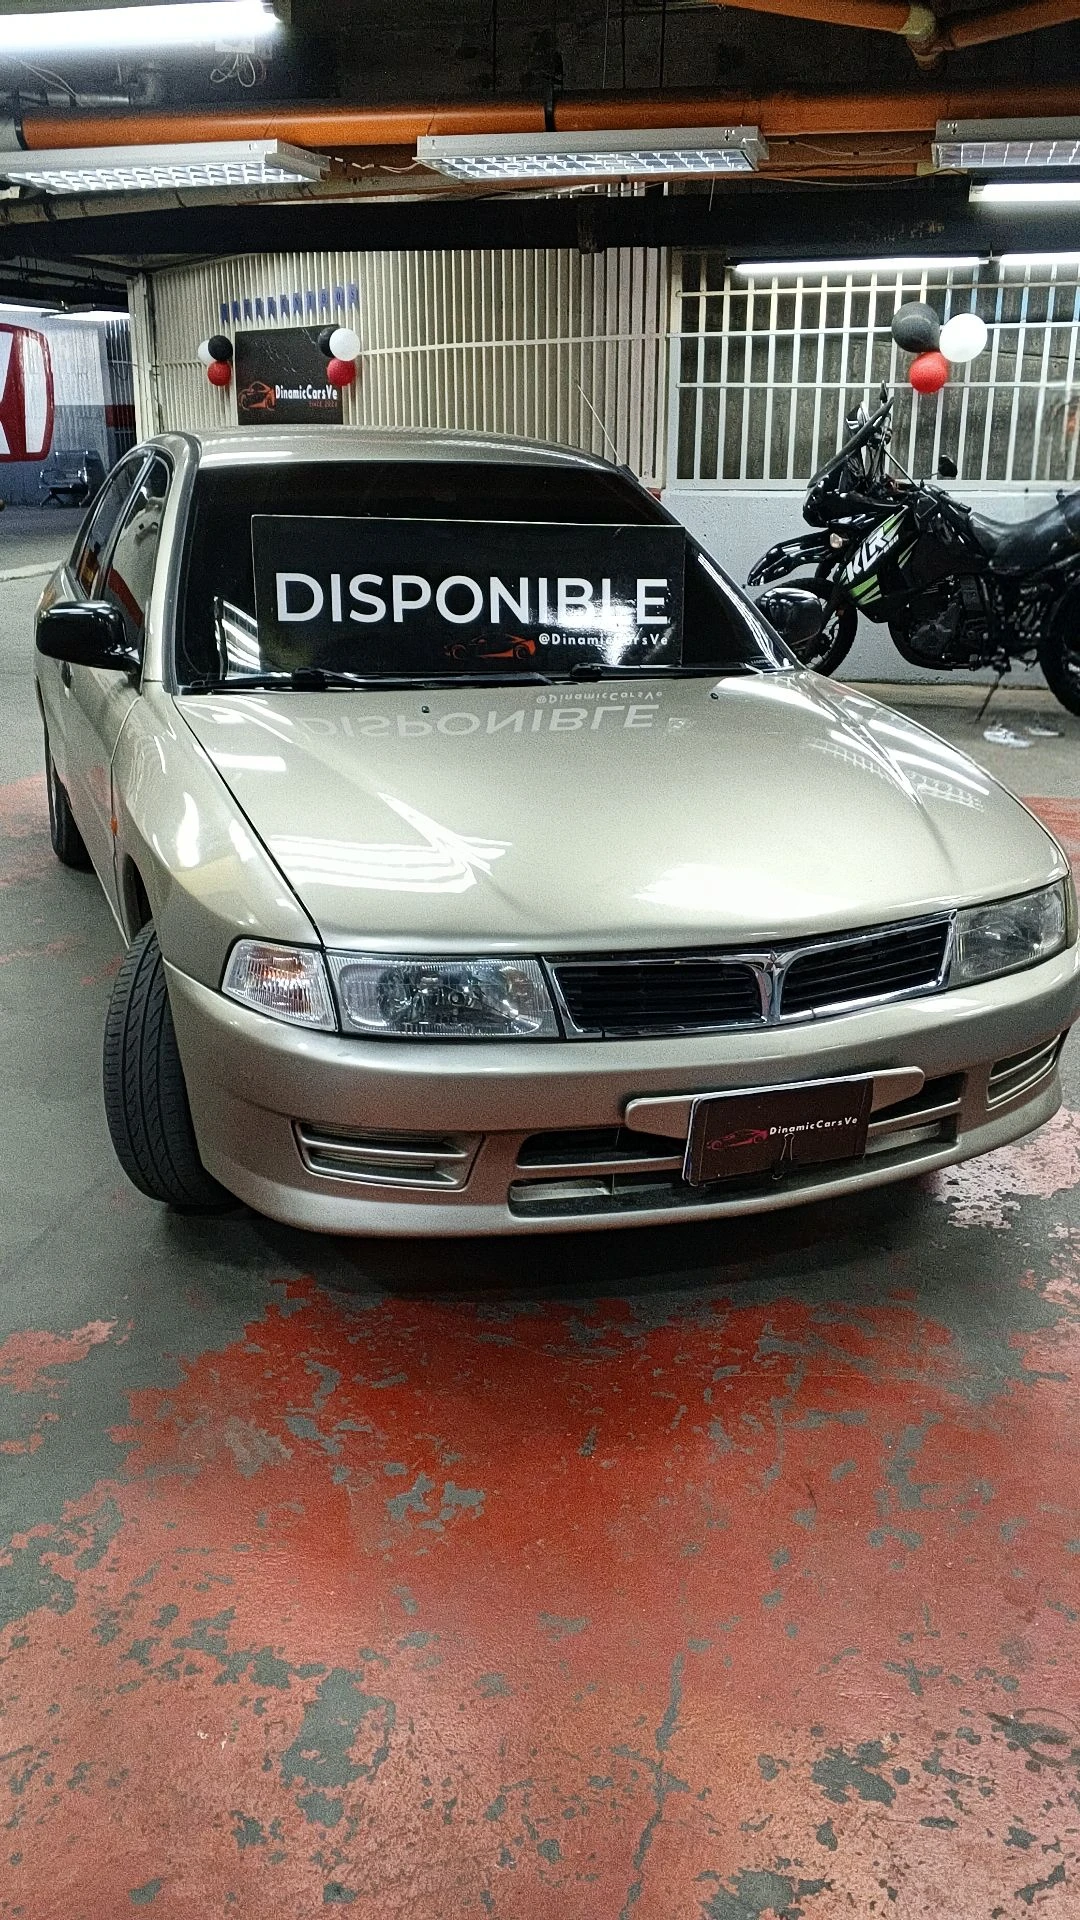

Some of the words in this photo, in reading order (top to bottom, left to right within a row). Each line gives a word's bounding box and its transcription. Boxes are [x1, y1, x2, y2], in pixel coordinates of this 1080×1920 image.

[275, 384, 338, 400] DinamicCarsVe
[846, 526, 886, 583] KLR
[275, 572, 669, 625] DISPONIBLE
[538, 632, 668, 646] @DinamicarsVe
[769, 1116, 858, 1136] DinamicCarsVe
